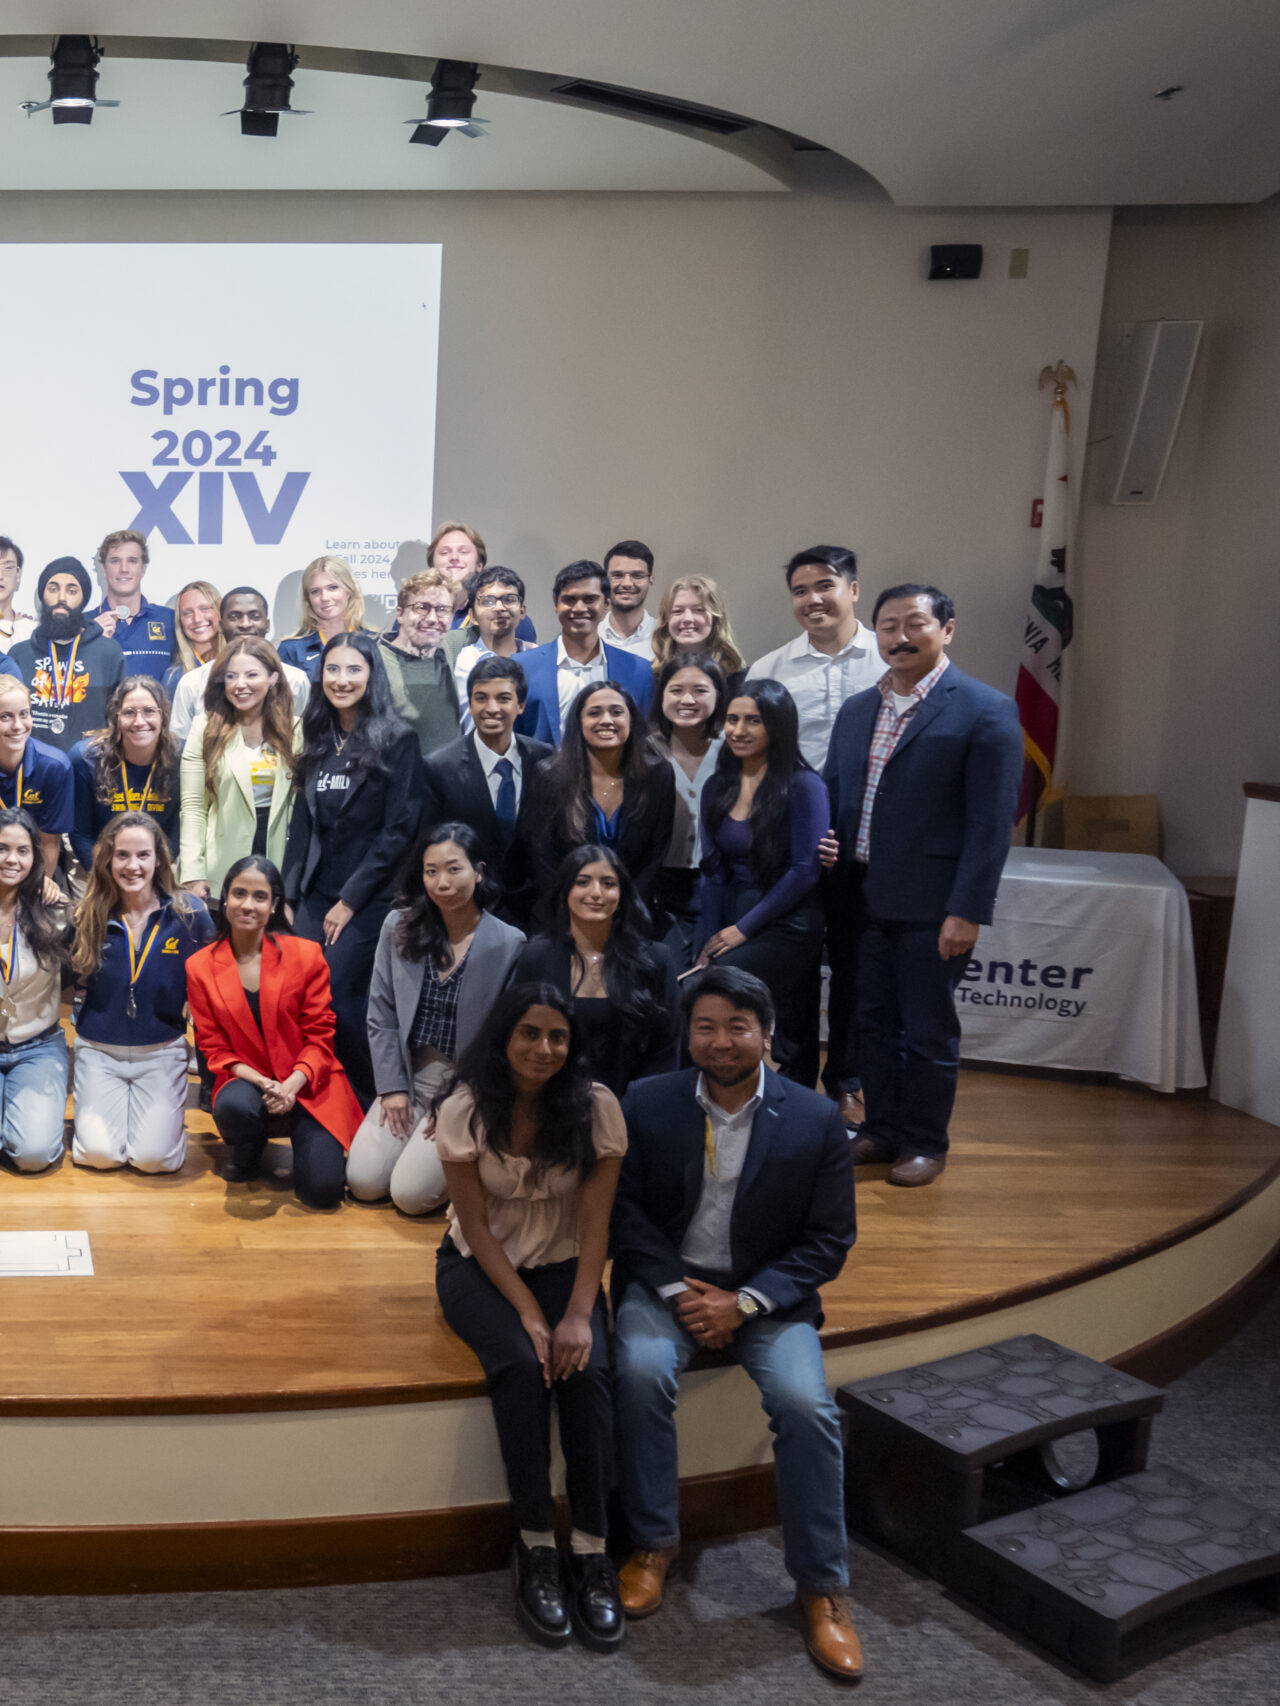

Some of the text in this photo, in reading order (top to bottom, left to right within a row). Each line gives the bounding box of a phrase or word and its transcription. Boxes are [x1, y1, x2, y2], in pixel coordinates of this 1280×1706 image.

[130, 365, 299, 416] Spring
[151, 430, 277, 467] 2024
[118, 471, 312, 545] XIV
[325, 539, 400, 549] Learn about
[360, 554, 390, 564] 2024
[23, 788, 41, 801] Cal
[963, 958, 1094, 990] enter
[958, 986, 1087, 1018] Technology
